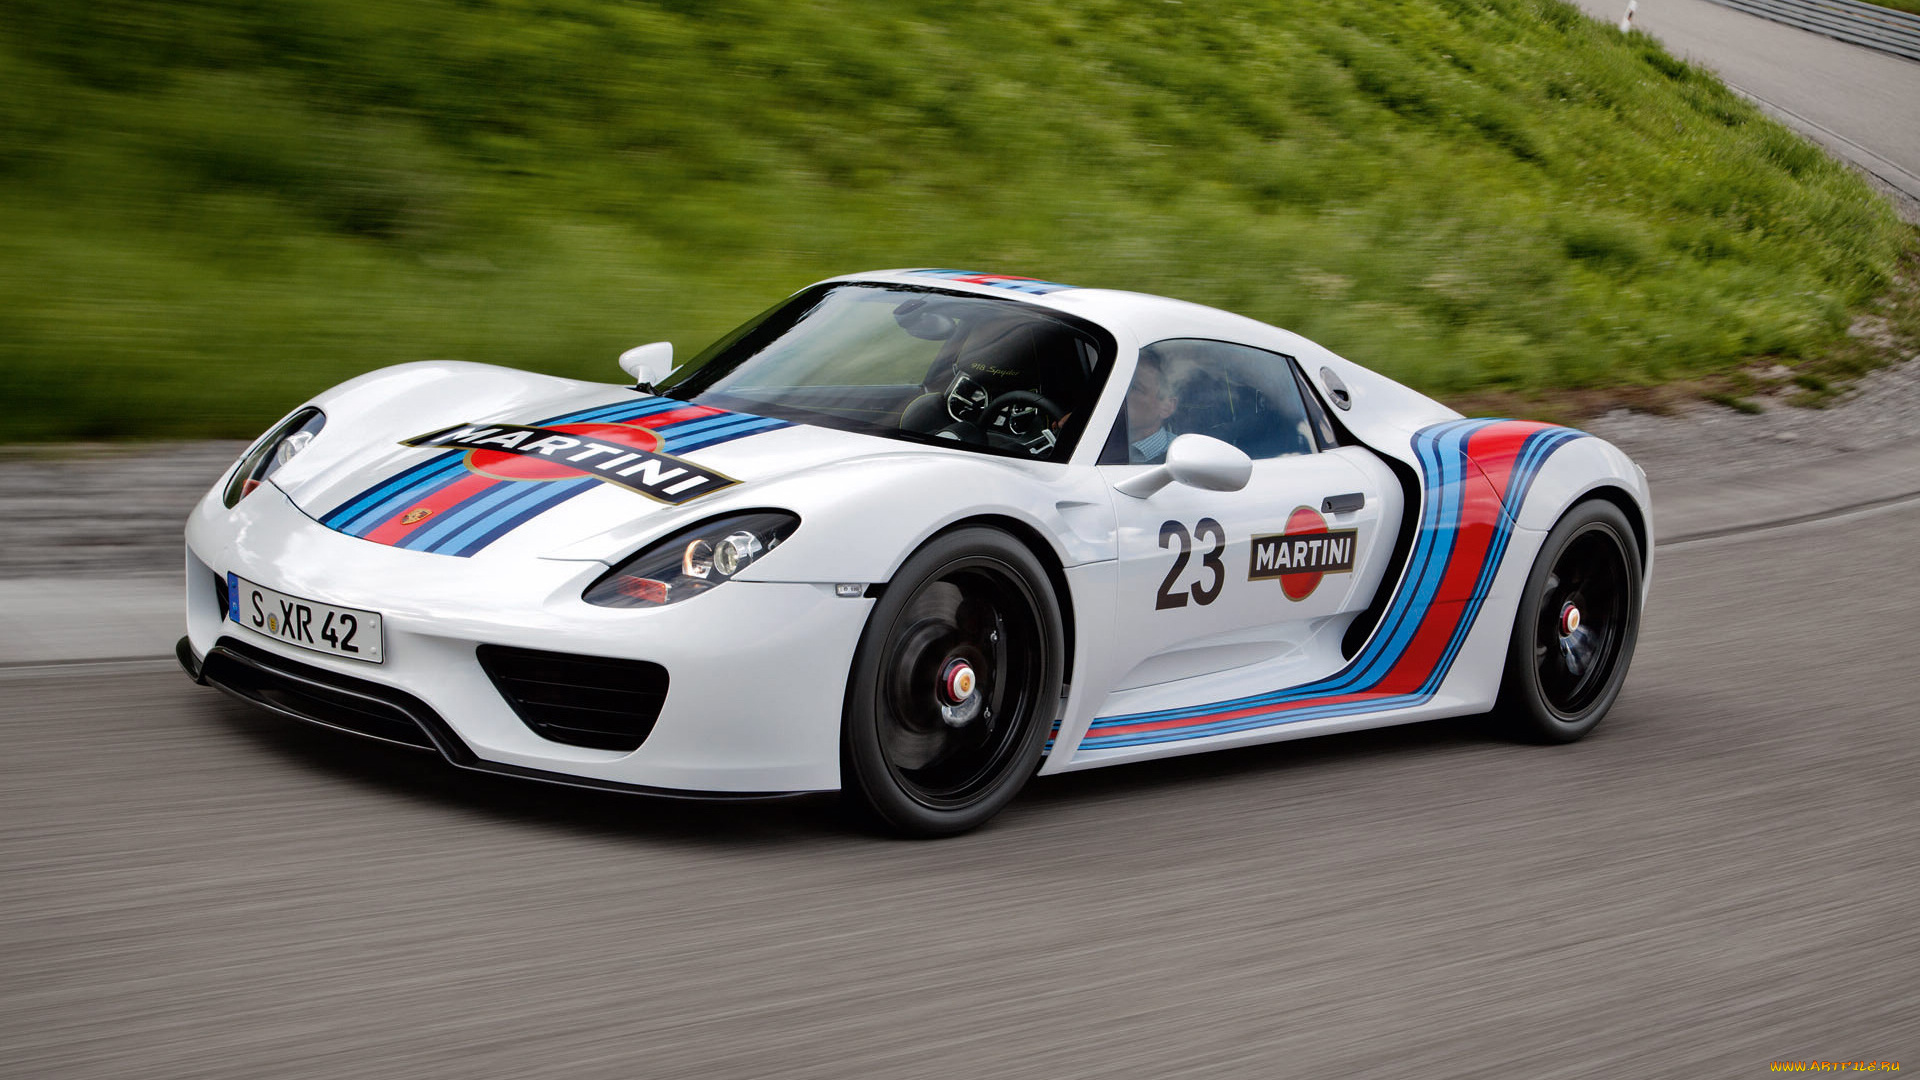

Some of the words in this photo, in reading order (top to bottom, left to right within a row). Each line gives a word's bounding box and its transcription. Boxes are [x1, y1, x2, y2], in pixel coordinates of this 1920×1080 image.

[971, 363, 985, 371] 918
[987, 366, 1019, 377] Spyder
[430, 427, 710, 496] MARTINI
[1155, 517, 1226, 611] 23
[1256, 538, 1351, 571] MARTINI
[252, 591, 265, 627] S
[280, 600, 314, 643] XR
[321, 612, 359, 652] 42
